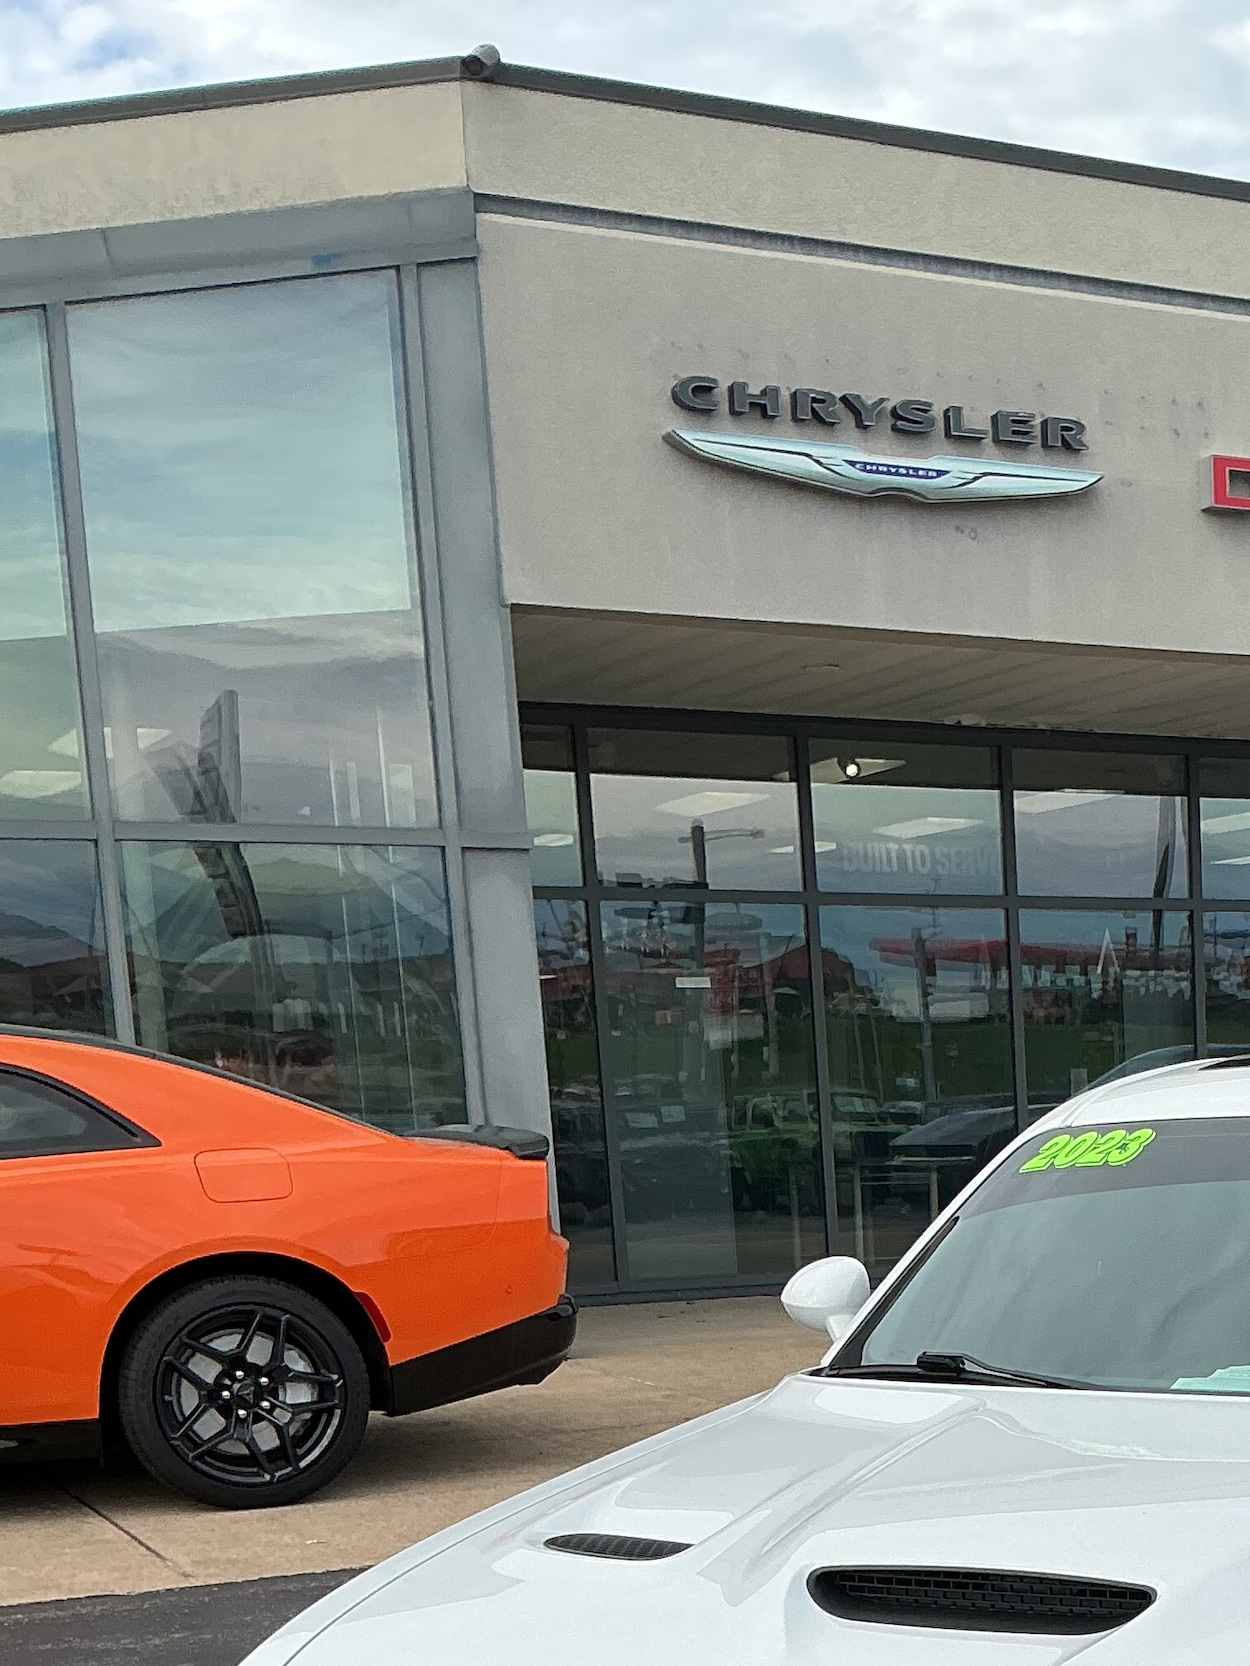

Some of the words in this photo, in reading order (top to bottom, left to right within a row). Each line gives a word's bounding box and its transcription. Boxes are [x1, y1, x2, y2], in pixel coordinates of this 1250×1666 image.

[671, 375, 1089, 450] CHRYSLER
[854, 463, 938, 477] CHRYSLER
[843, 841, 899, 873] BUILT
[902, 843, 931, 874] TO
[1018, 1128, 1156, 1173] 2023
